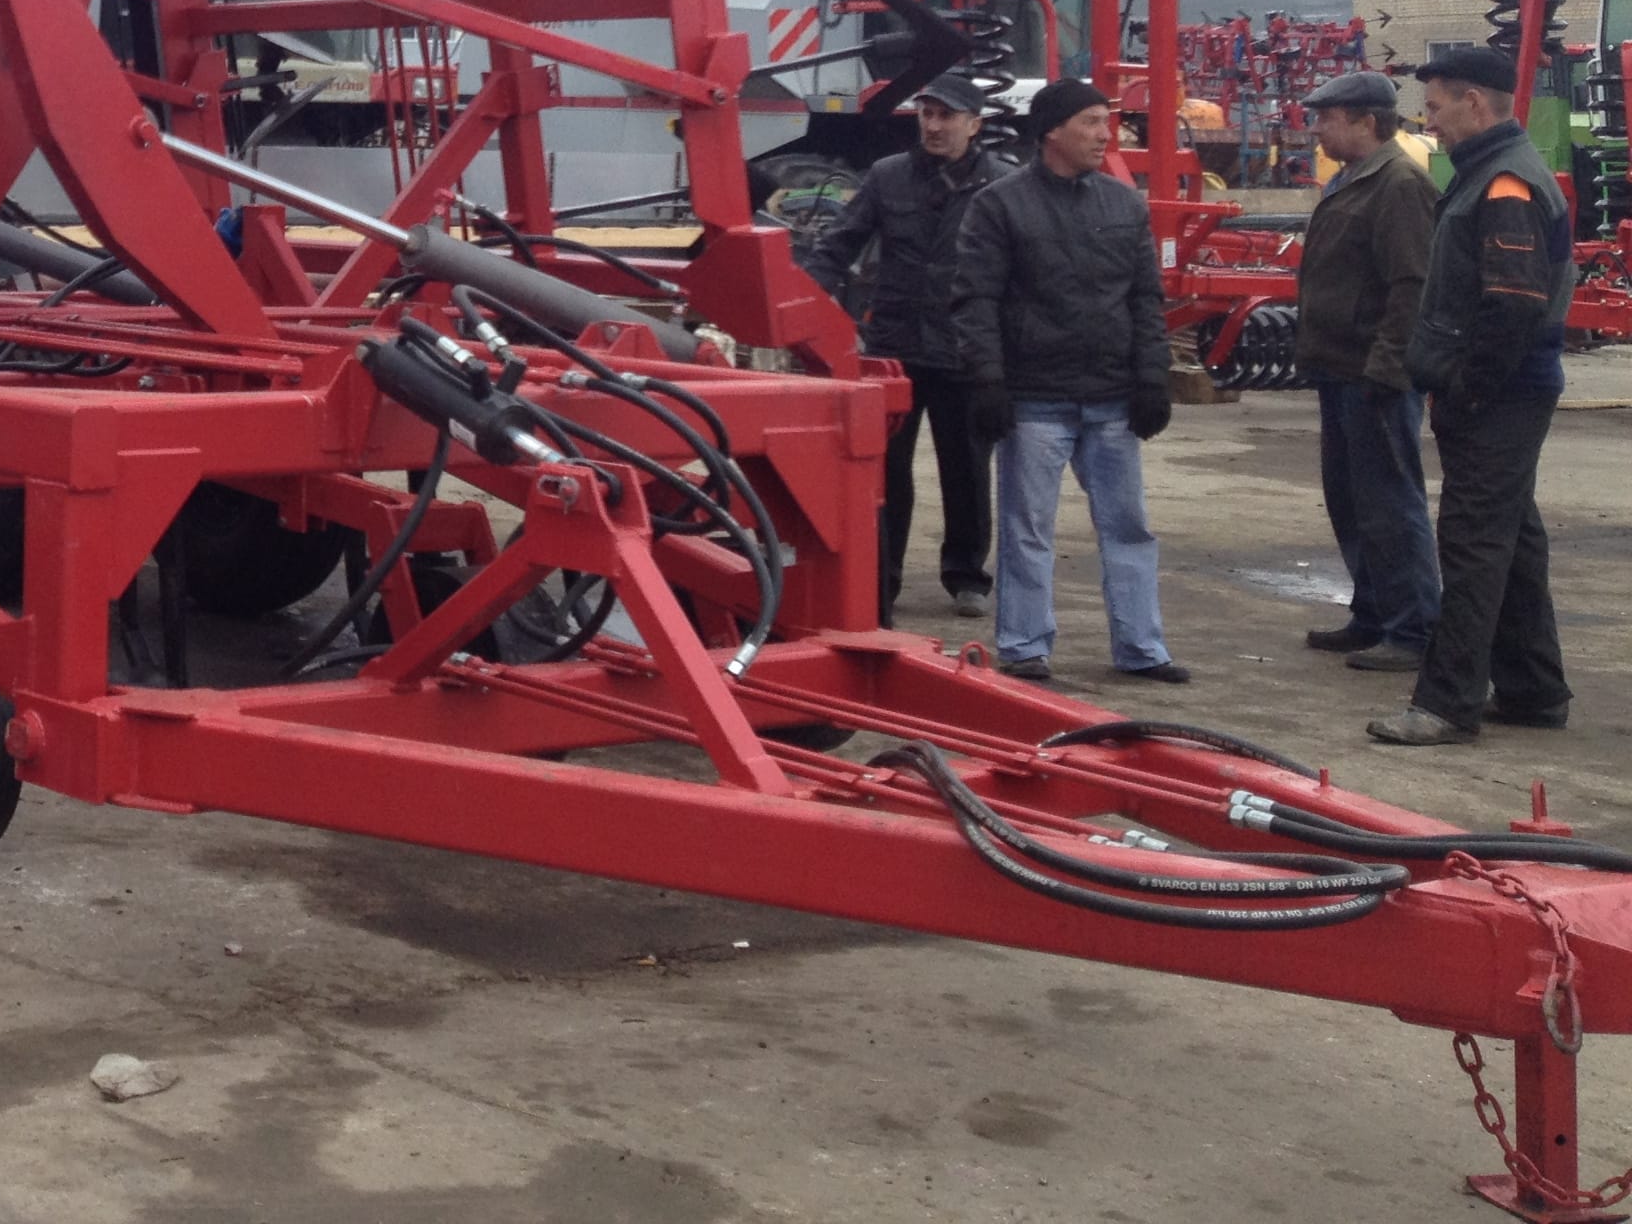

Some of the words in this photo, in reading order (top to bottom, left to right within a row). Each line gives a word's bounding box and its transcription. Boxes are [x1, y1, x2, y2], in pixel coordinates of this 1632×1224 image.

[1151, 878, 1197, 891] SVAROG
[1200, 881, 1217, 891] EN
[1242, 881, 1265, 891] 2SN
[1296, 880, 1313, 890] DN
[1330, 878, 1348, 888] WP
[1350, 876, 1367, 886] 250
